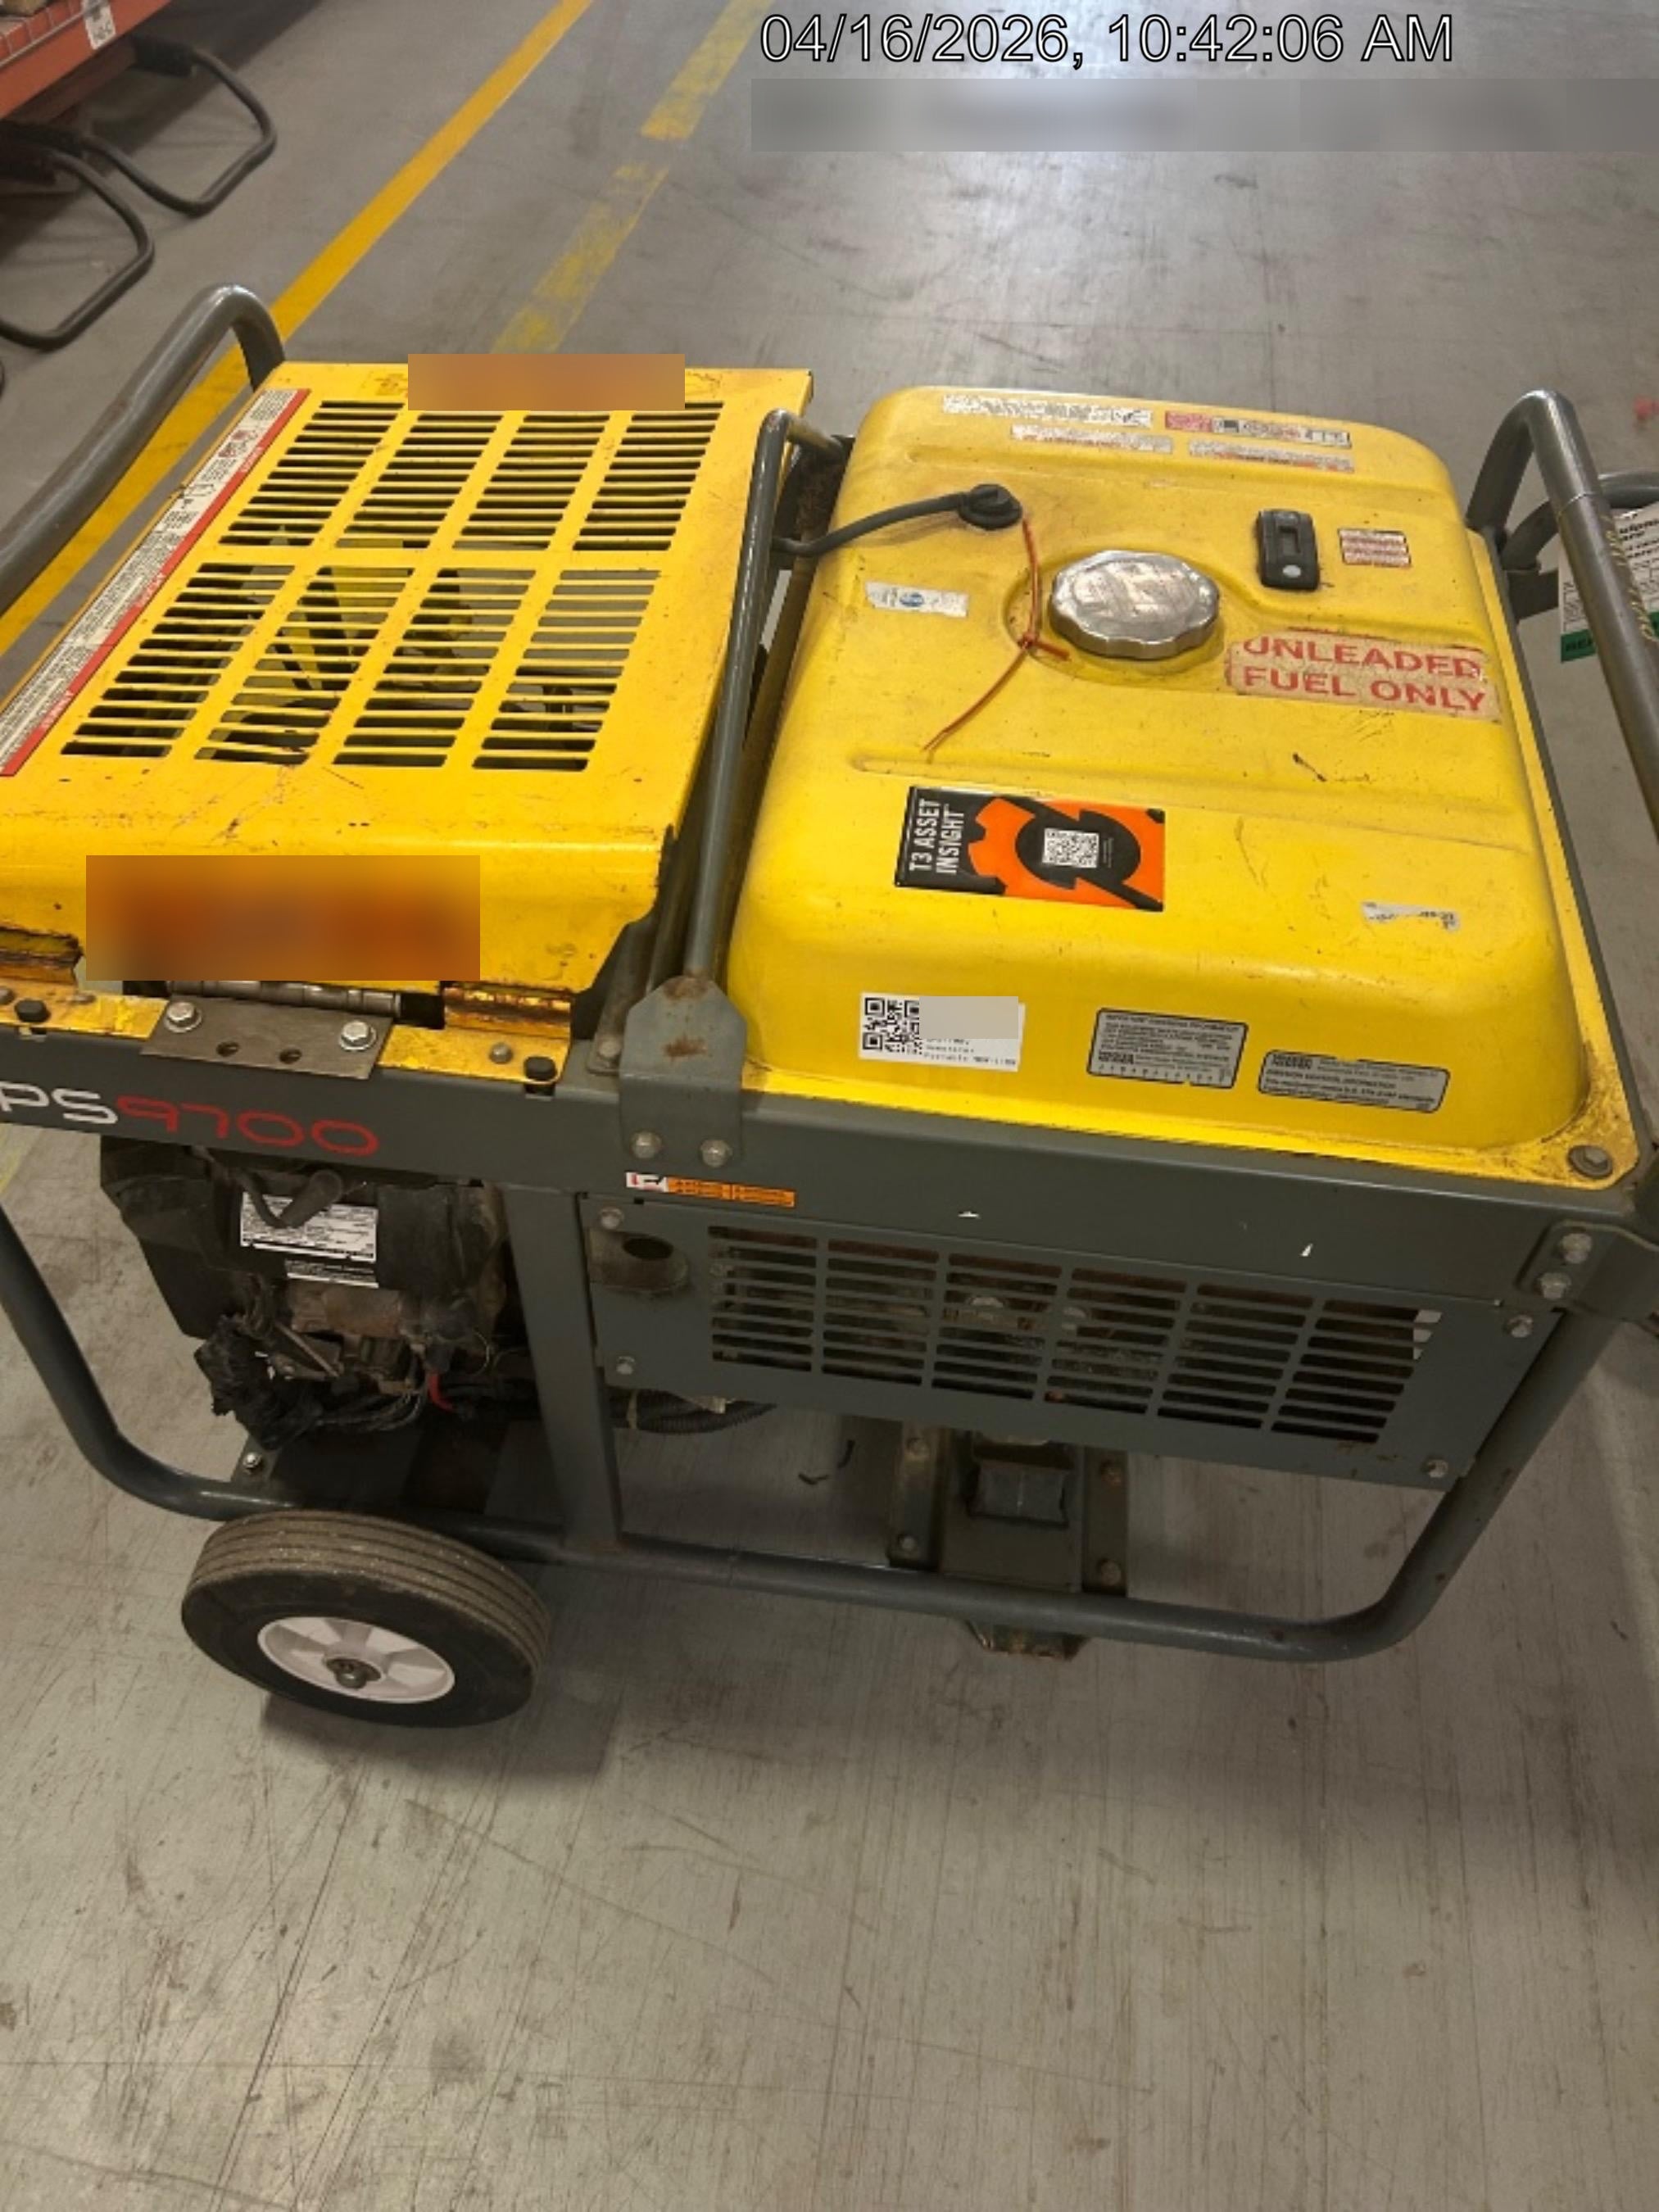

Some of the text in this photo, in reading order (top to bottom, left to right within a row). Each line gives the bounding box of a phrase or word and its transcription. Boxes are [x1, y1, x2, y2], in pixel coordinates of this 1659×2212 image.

[1243, 636, 1481, 678] UNLEADED
[1243, 666, 1485, 711] FUEL ONLY
[909, 798, 941, 871] T3 ASSET
[936, 804, 964, 875] INSIGHT
